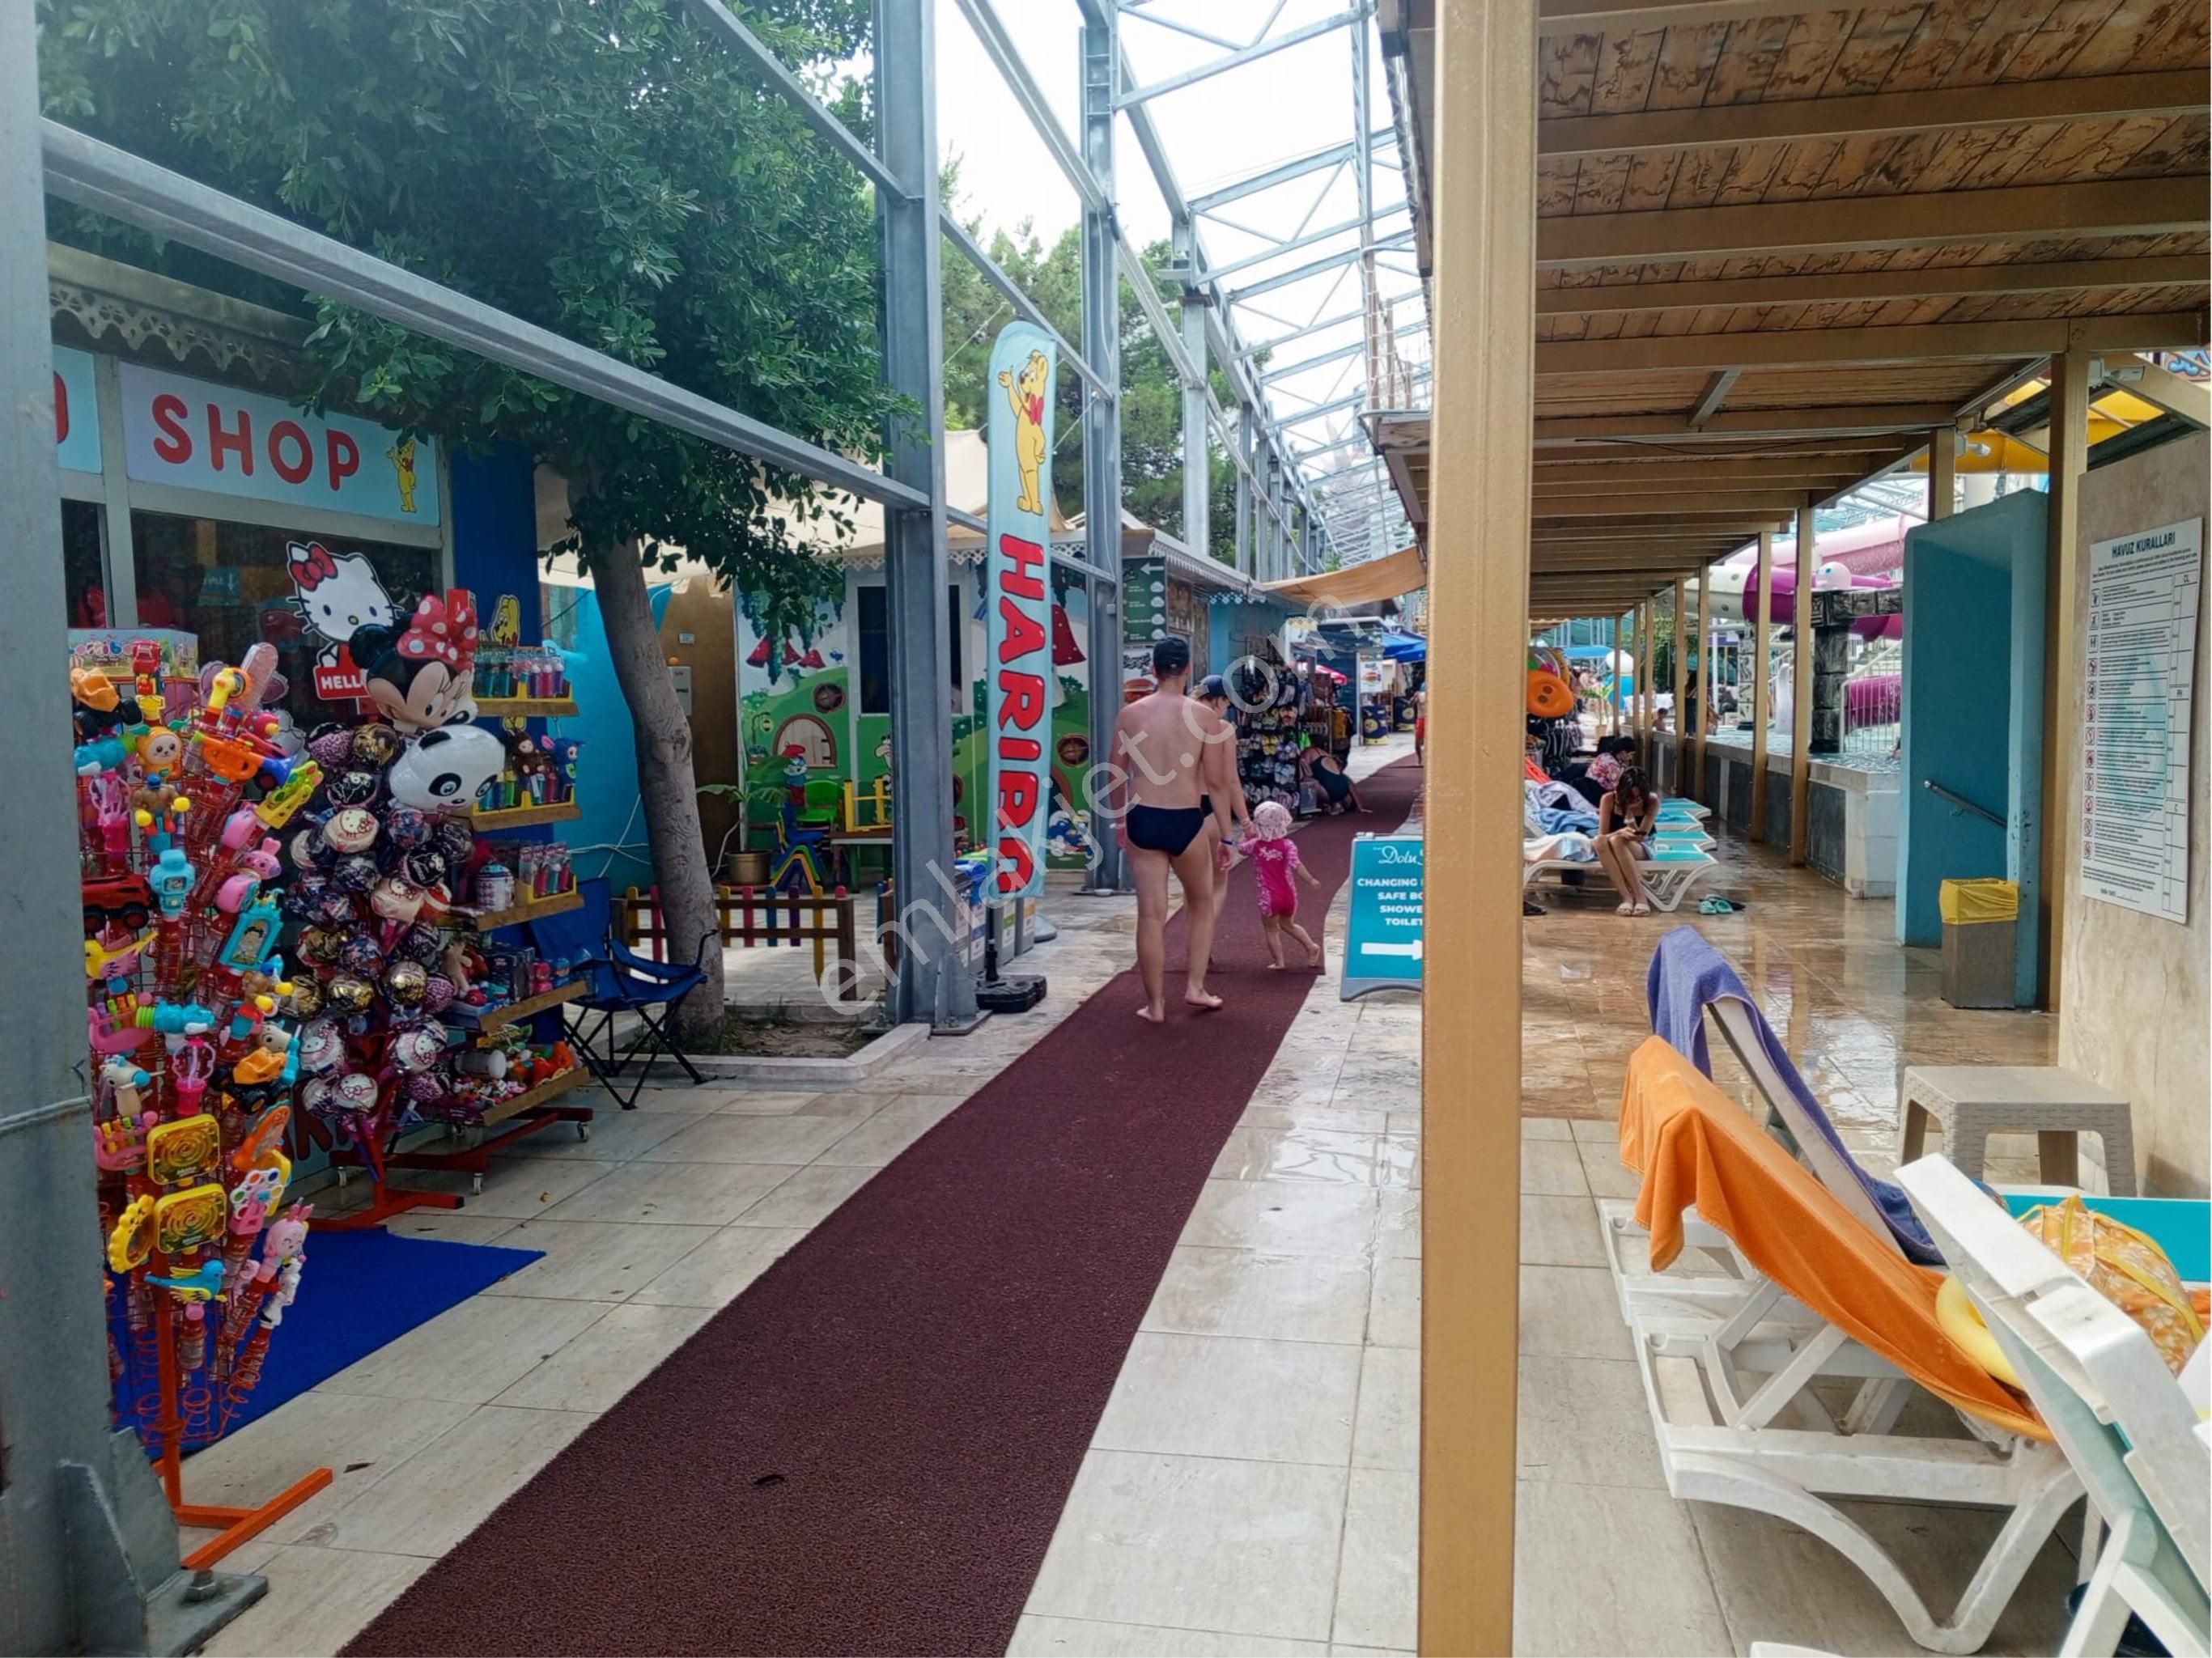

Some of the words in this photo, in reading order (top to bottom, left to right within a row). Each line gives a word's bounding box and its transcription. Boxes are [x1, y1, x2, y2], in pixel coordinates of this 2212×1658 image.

[151, 393, 360, 491] SHOP
[2112, 542, 2135, 558] HAVUZ
[2136, 531, 2176, 553] KURALLARI
[1378, 845, 1417, 864] Dolu
[1356, 878, 1418, 887] CHANGING
[1378, 892, 1407, 900] SAFE
